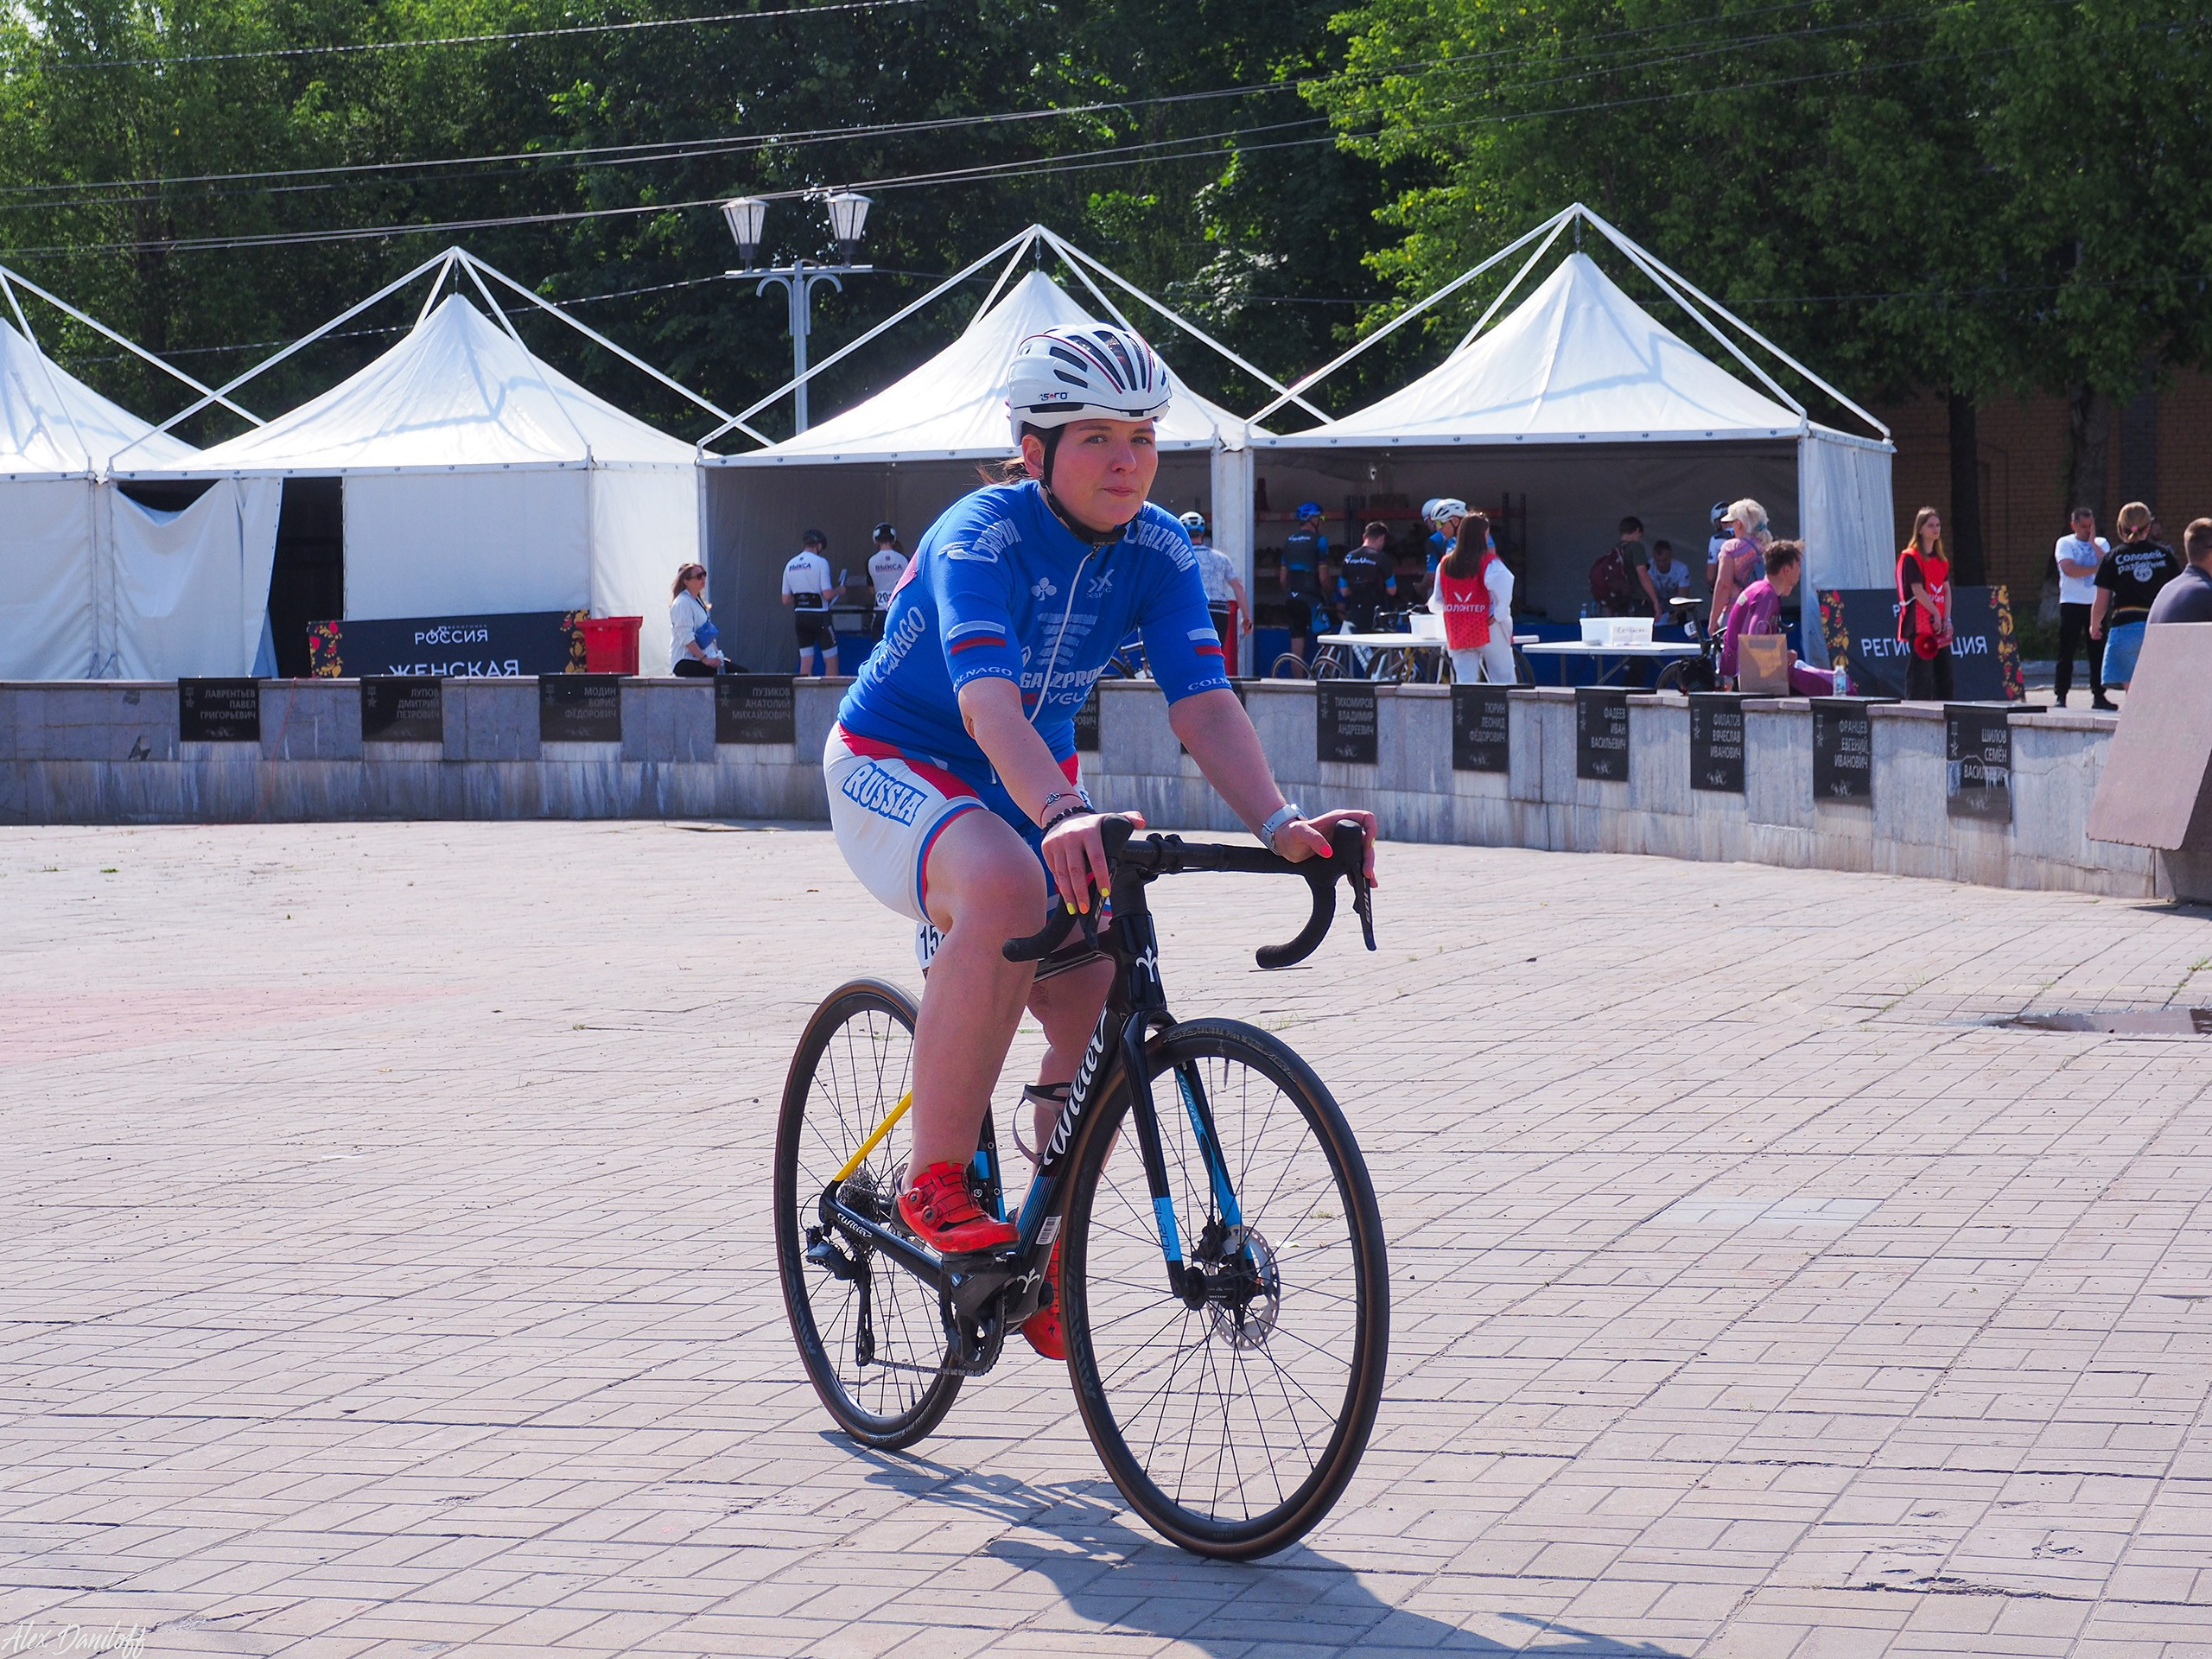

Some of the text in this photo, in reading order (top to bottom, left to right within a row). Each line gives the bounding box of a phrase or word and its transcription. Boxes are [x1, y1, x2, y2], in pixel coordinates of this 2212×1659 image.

[415, 628, 488, 645] РОССИЯ
[389, 659, 520, 677] ЖЕНСКАЯ
[1187, 677, 1232, 690] COLN
[205, 690, 256, 698] ЛАВРЕНТЬЕВ
[410, 689, 440, 697] ЛУПОВ
[584, 687, 616, 696] МОДИН
[752, 688, 791, 696] ПУЗИКОВ
[397, 699, 440, 709] ДМИТРИЙ
[588, 698, 616, 707] БОРИС
[745, 697, 791, 708] АНАТОЛИЙ
[397, 710, 440, 719] ПЕТРОВИЧ
[564, 708, 617, 719] ФЁДОРОВИЧ
[732, 709, 791, 719] МИХАЙЛОВИЧ
[1981, 728, 2007, 743] ШИЛОВ
[1710, 746, 1742, 759] ИВАНОВИЧ
[1985, 745, 2007, 763] СЕМЁН
[1834, 753, 1868, 769] ИВАНОВИЧ
[842, 762, 928, 827] RUSSIA
[920, 925, 946, 960] 15
[1044, 1005, 1108, 1166] Wilier
[836, 1212, 873, 1238] Wilier
